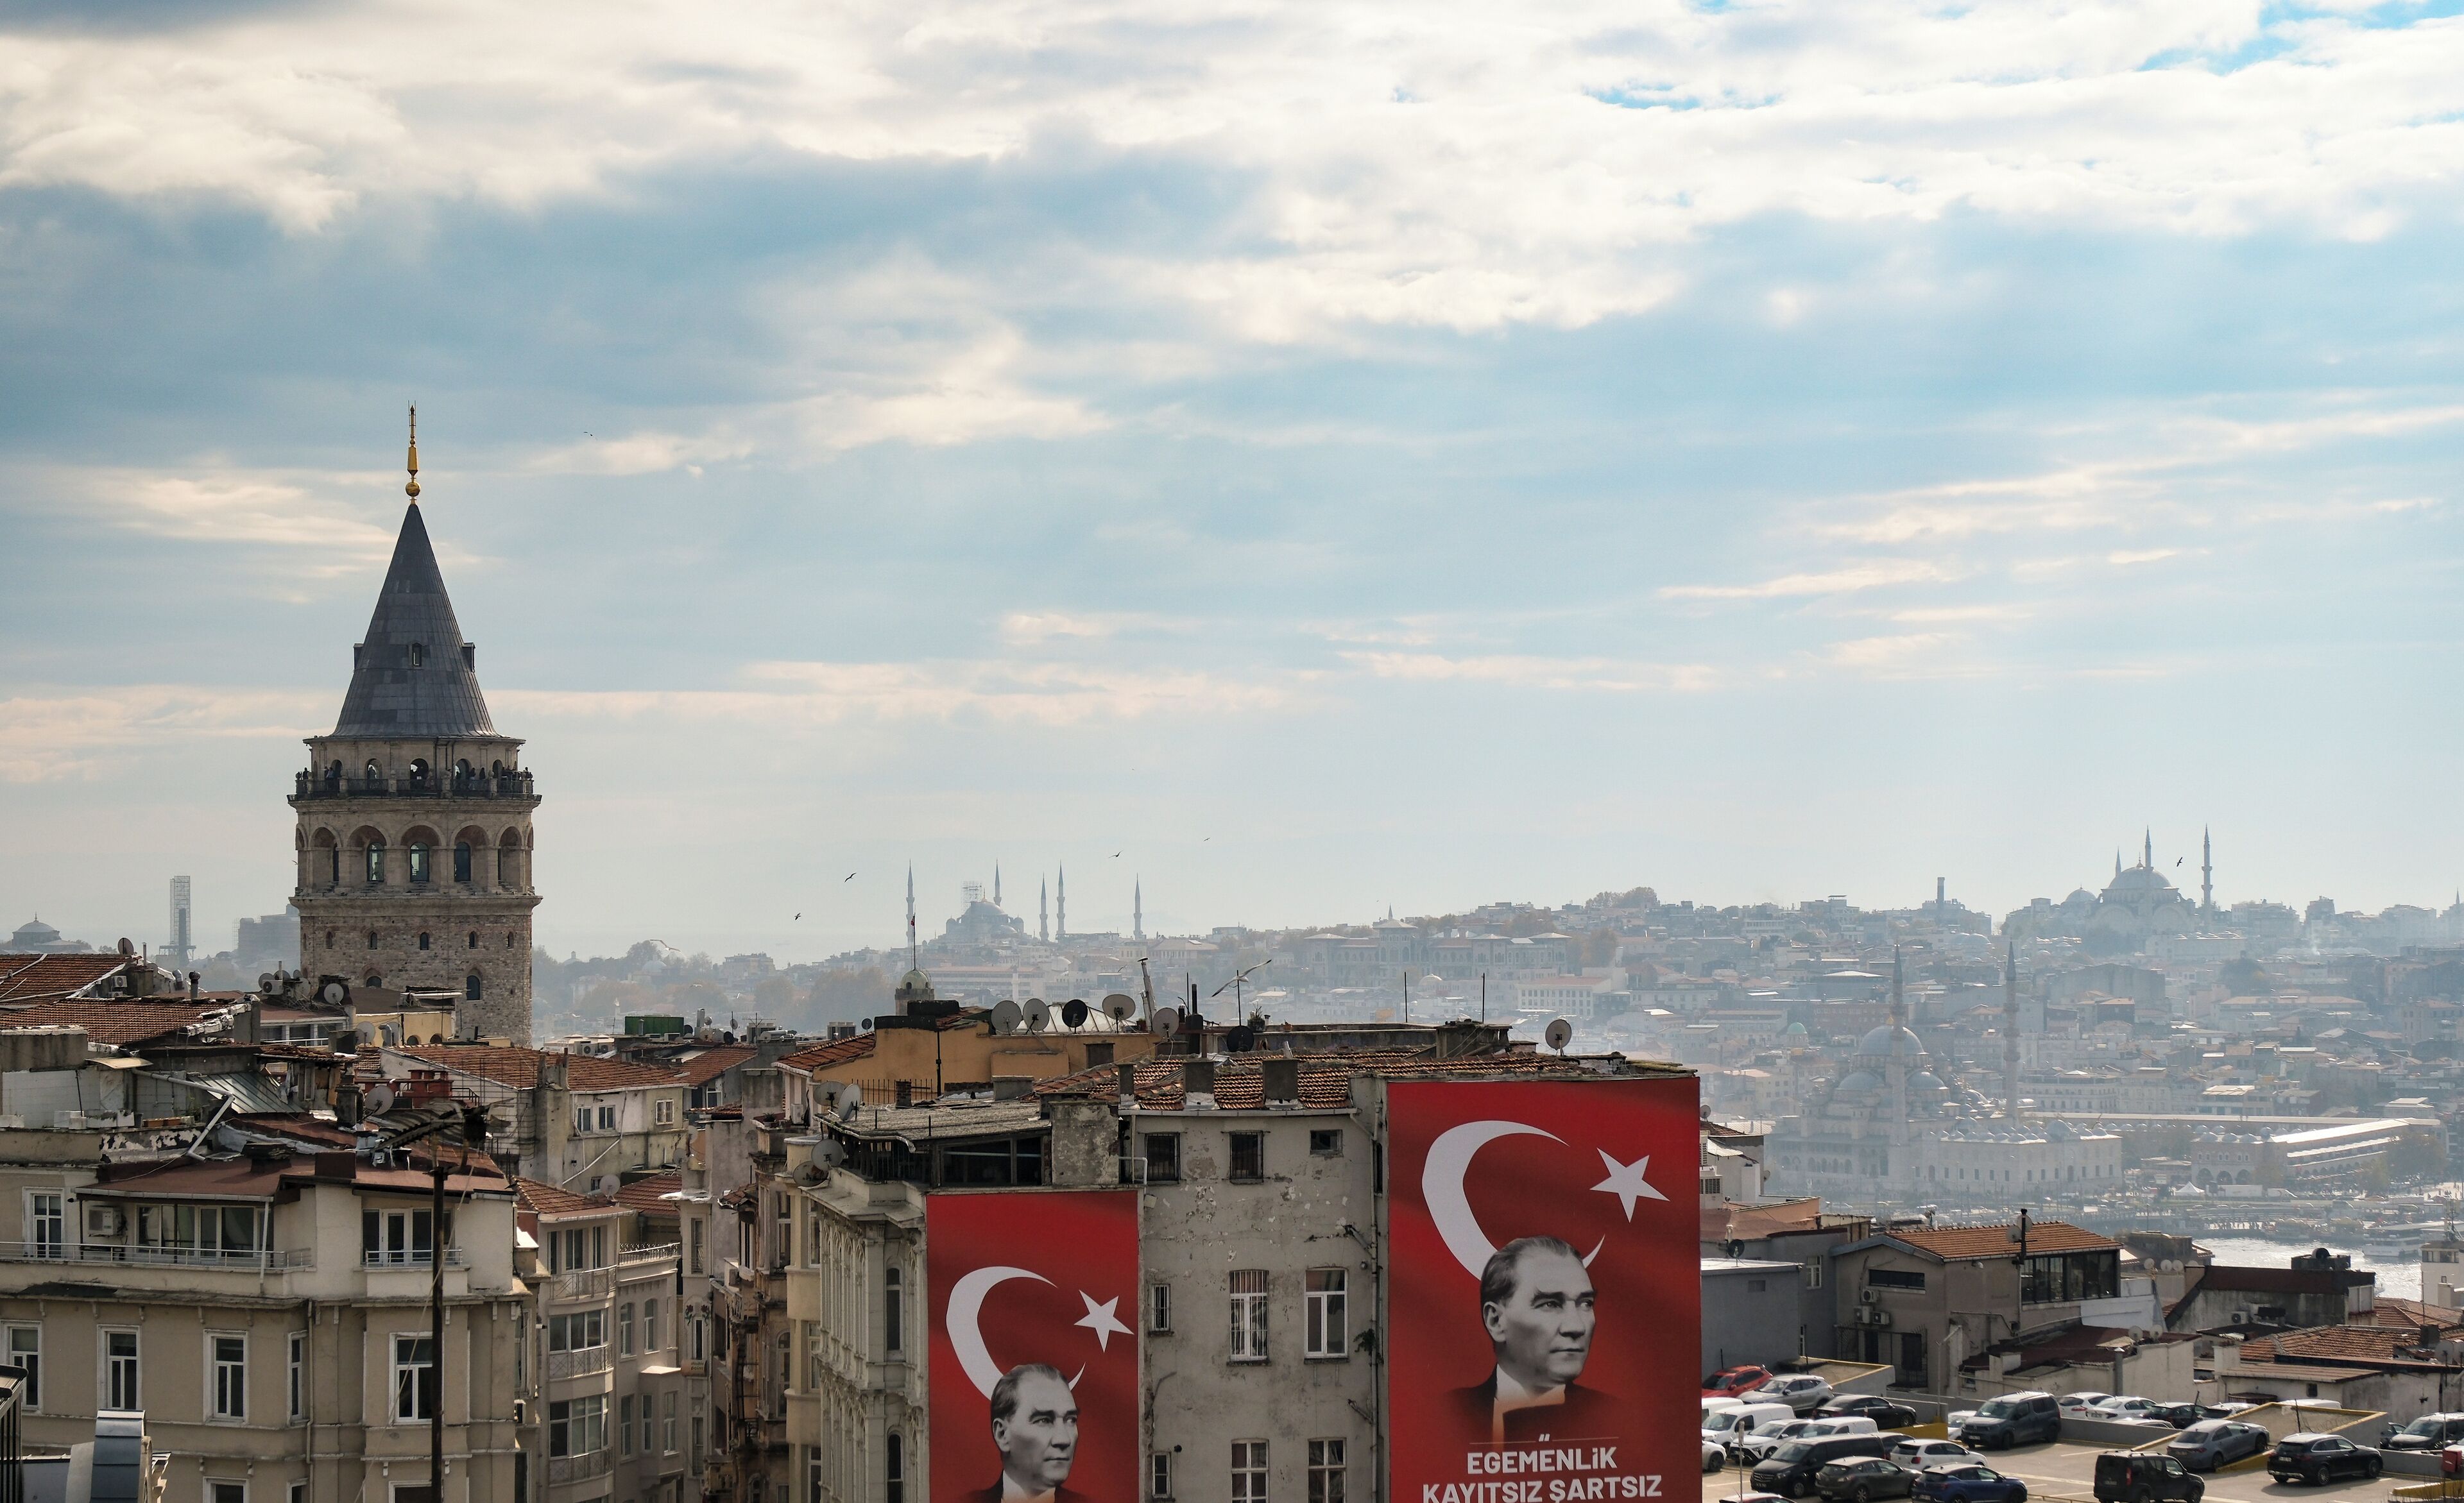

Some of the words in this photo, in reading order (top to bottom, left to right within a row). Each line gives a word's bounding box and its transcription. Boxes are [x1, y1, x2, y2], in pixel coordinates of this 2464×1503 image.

[1467, 1447, 1618, 1475] EGEMENLİK
[1423, 1481, 1543, 1503] KAYITSIZ
[1549, 1475, 1663, 1503] ŞARTSIZ
